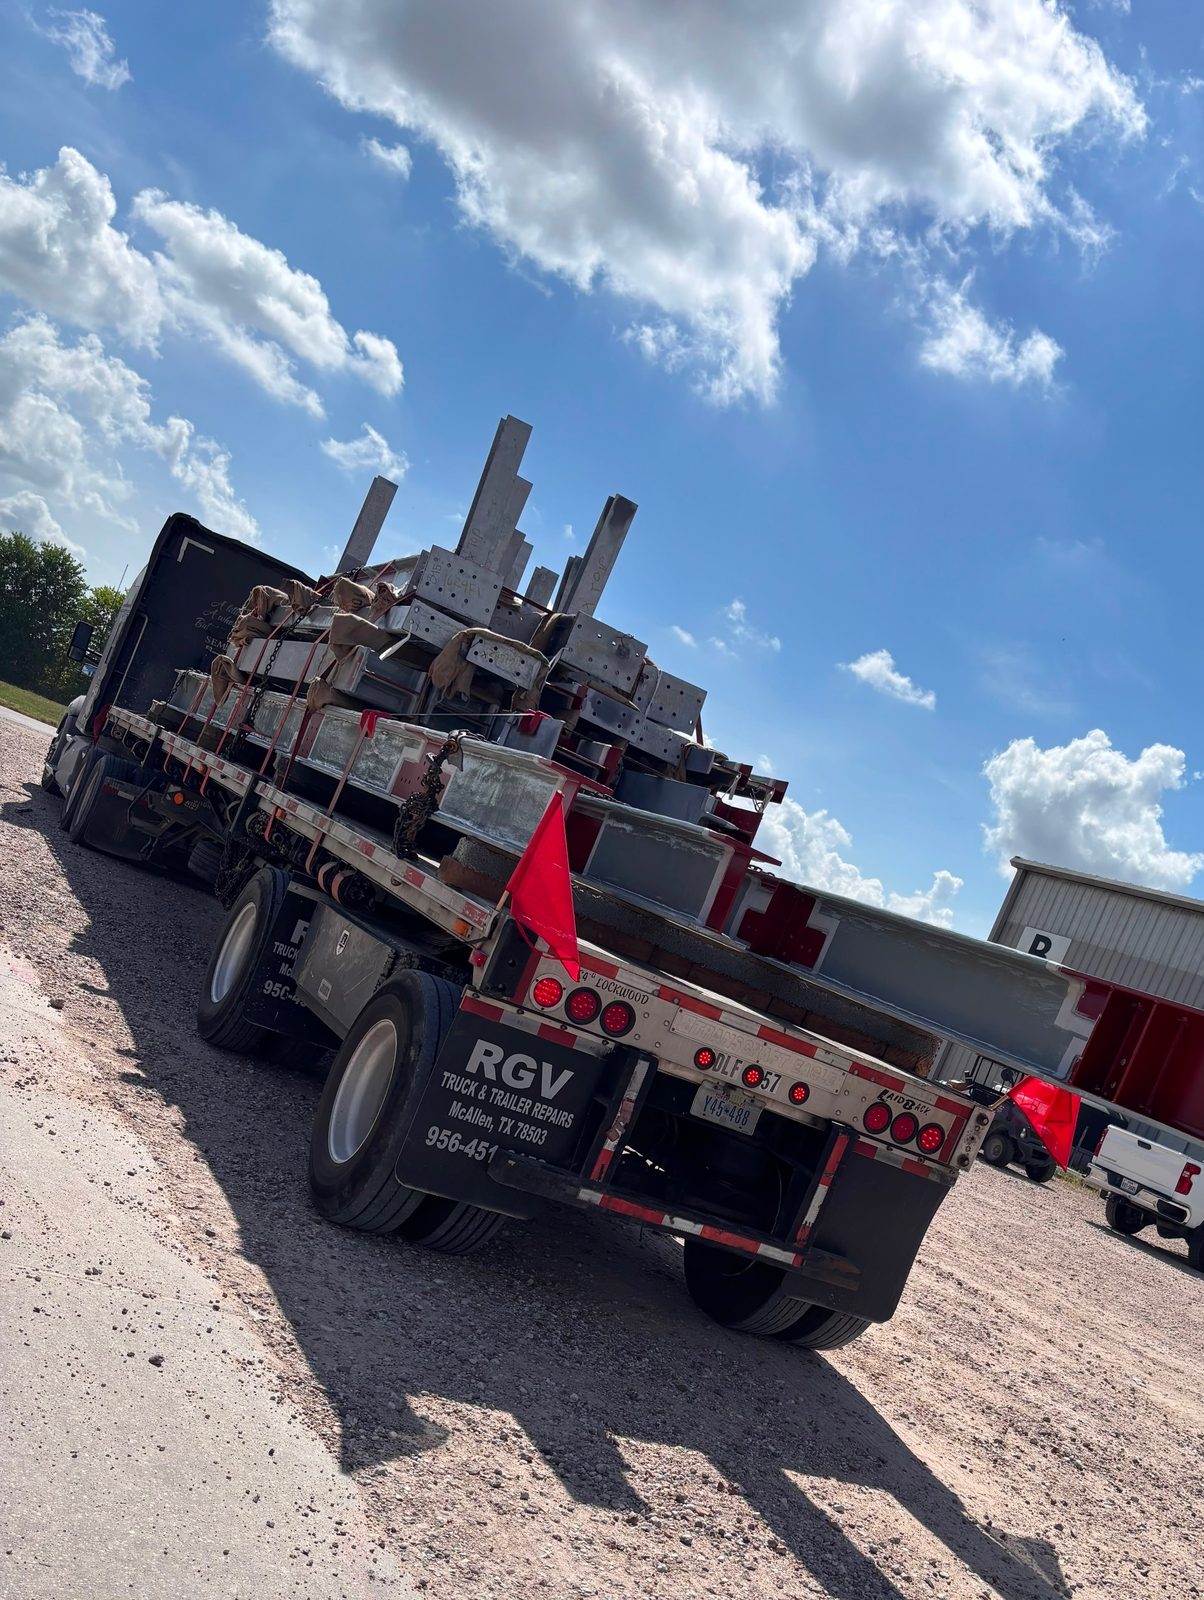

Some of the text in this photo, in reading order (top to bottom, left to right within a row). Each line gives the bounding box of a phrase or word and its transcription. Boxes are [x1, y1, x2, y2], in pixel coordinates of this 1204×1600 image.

[273, 941, 299, 960] TRUCK
[594, 978, 649, 1005] LOCKWOOD
[465, 1039, 574, 1100] RGV
[711, 1052, 743, 1078] DLF
[441, 1071, 574, 1129] TRUCK & TRAILER REPAIRS
[448, 1100, 548, 1145] McAllen, TX 78503
[425, 1125, 499, 1164] 956-451
